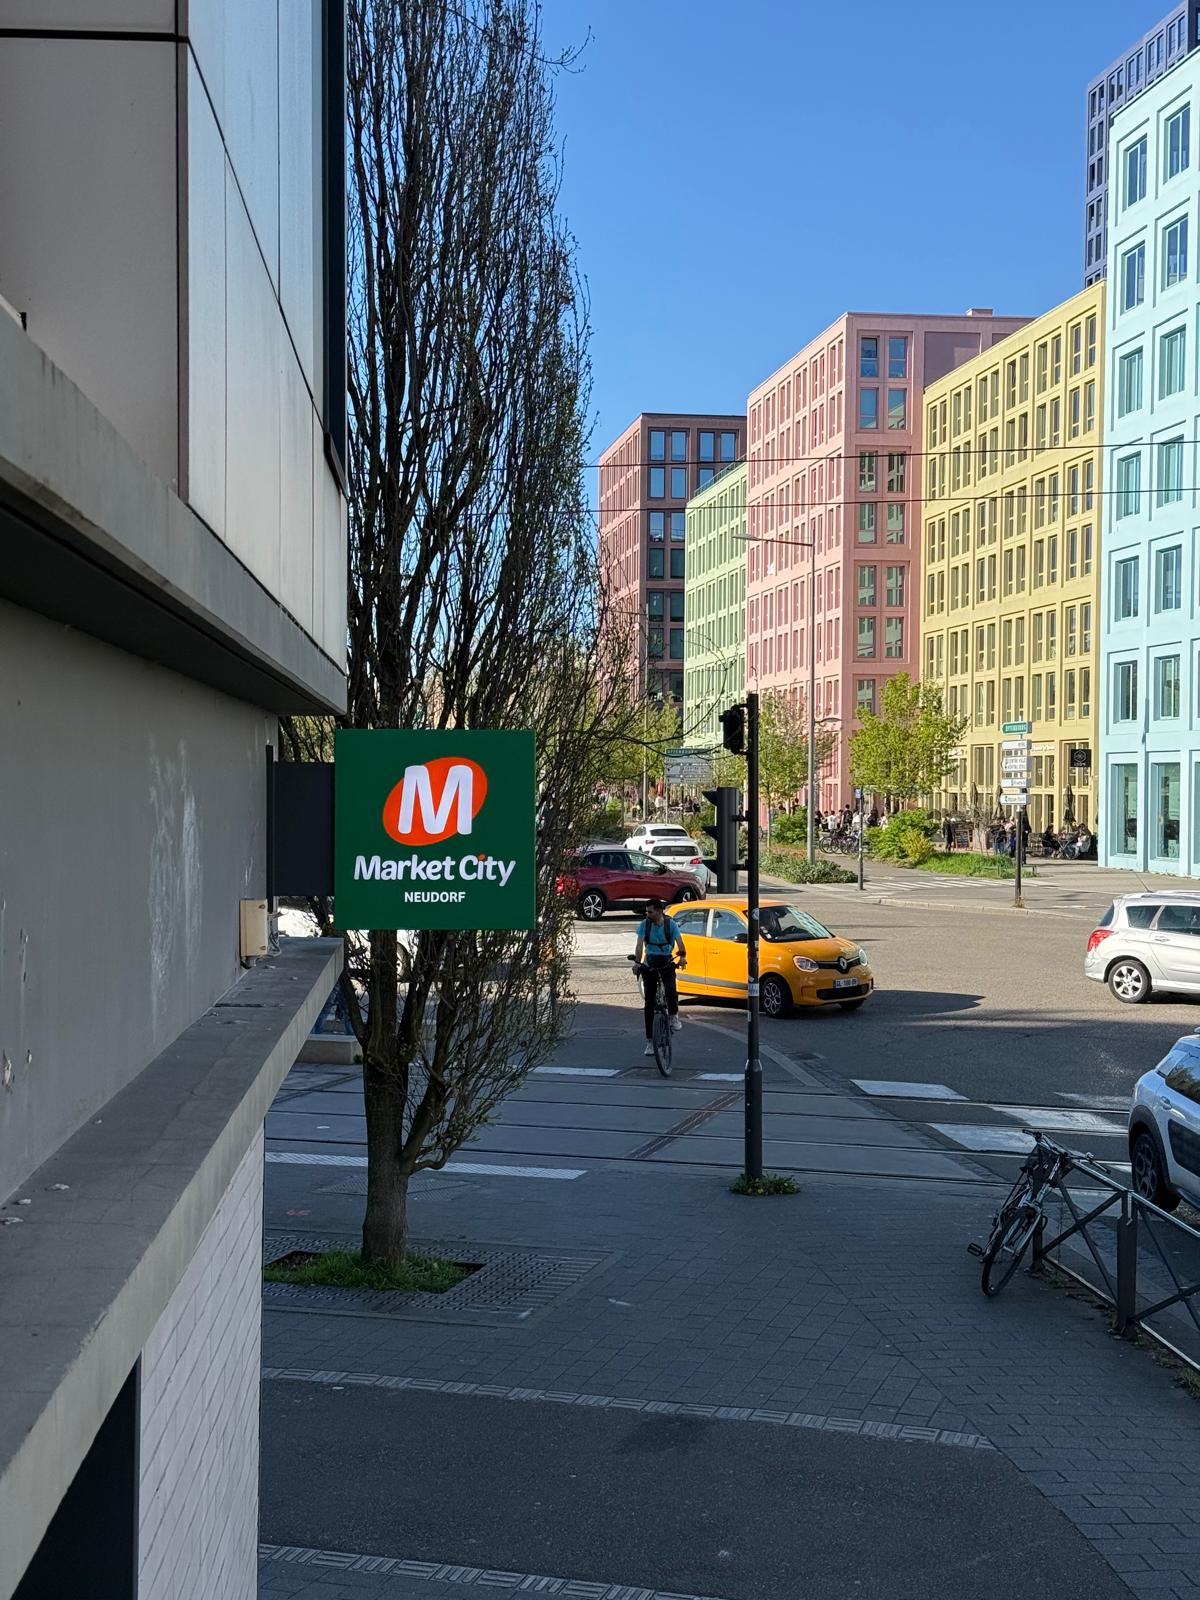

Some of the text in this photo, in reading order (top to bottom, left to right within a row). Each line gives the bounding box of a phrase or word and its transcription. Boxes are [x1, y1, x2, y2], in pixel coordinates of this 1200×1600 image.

[398, 764, 474, 835] M
[354, 853, 517, 887] Market City
[404, 891, 467, 903] NEUDORF
